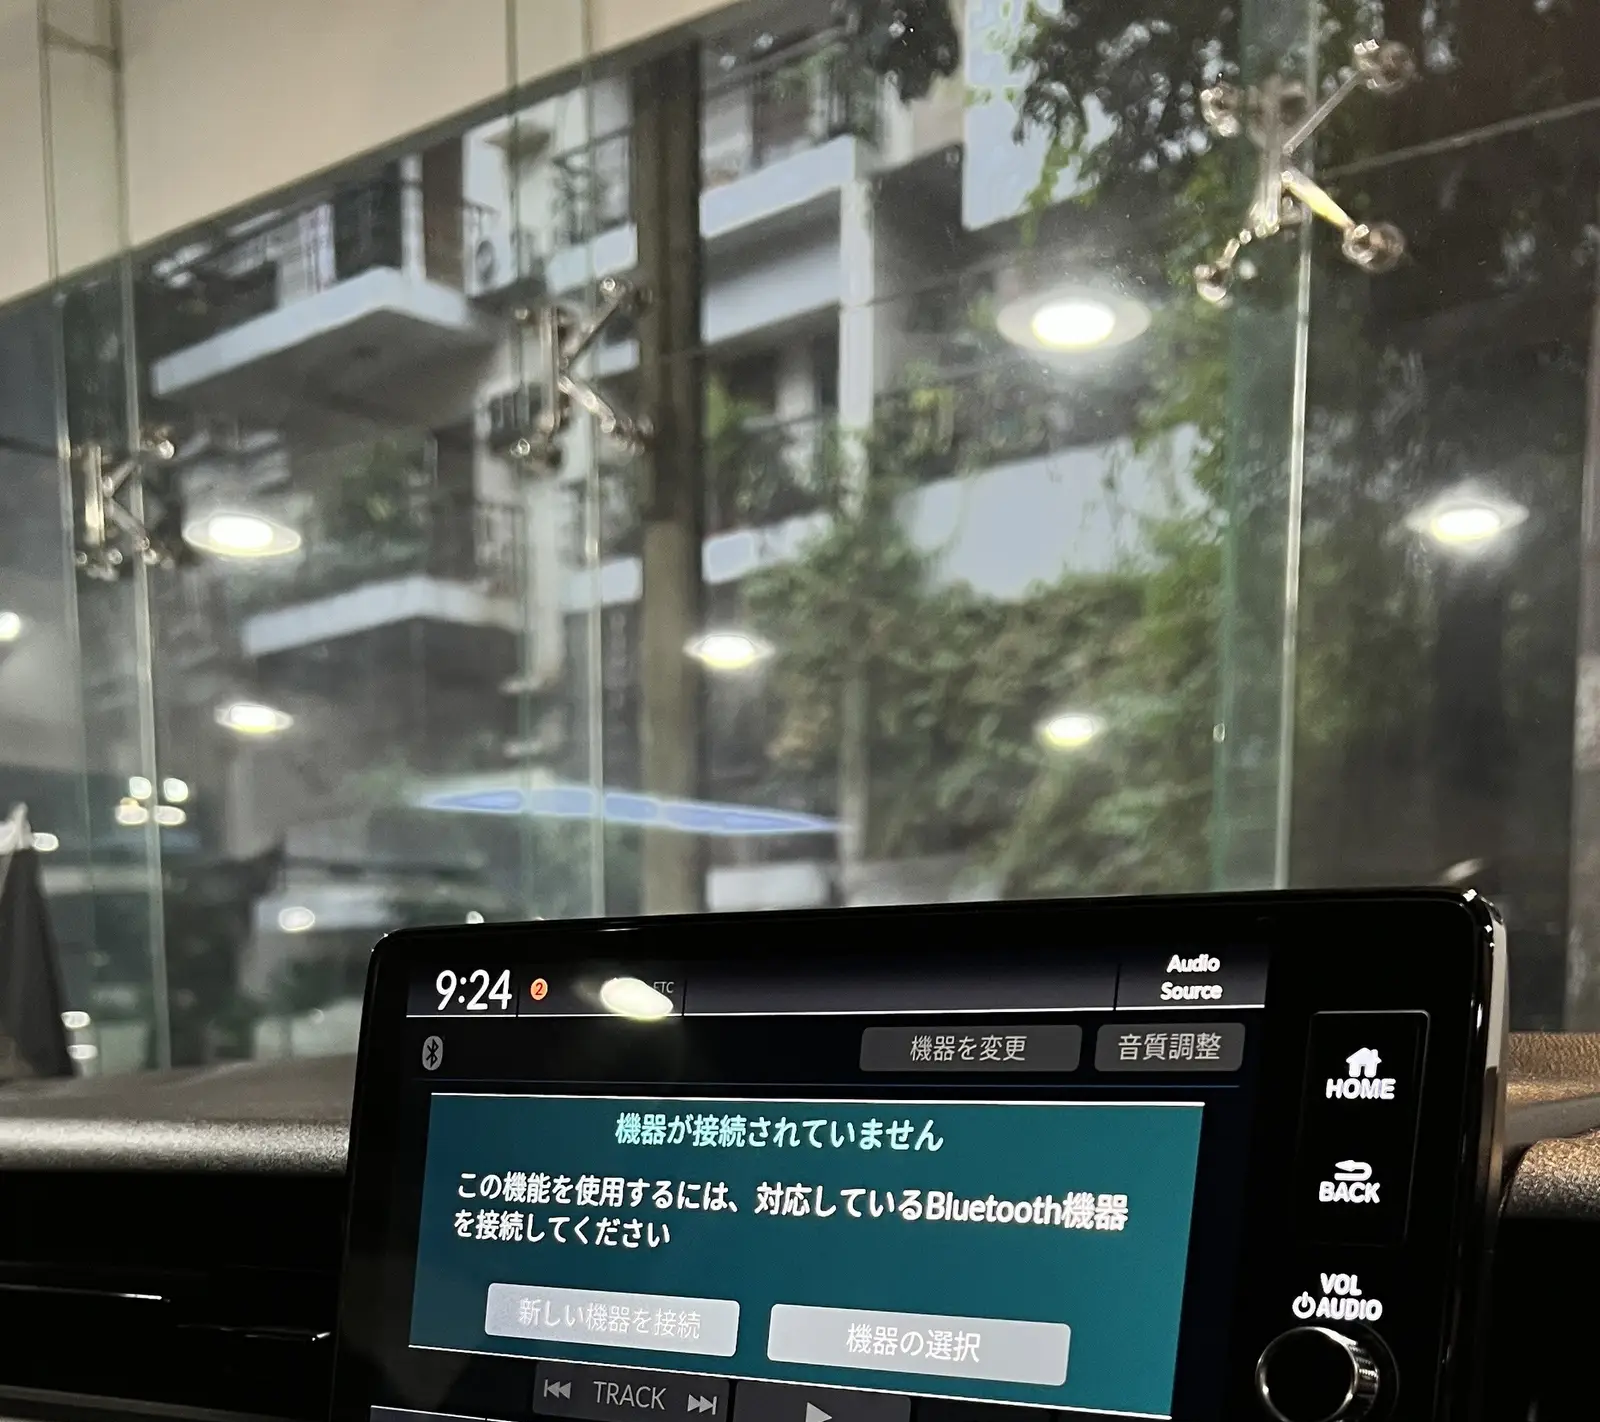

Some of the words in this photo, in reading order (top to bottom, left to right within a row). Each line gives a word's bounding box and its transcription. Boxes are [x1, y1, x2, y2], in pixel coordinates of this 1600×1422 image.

[1167, 953, 1221, 974] Audio
[435, 968, 512, 1011] 9:24
[1160, 979, 1223, 1001] Source
[910, 1034, 1027, 1063] 機器を変更
[1118, 1032, 1222, 1062] 音質調整
[1325, 1078, 1396, 1101] HOME
[615, 1111, 945, 1153] 機器が接続されていません
[1318, 1181, 1381, 1205] BACK
[451, 1209, 672, 1249] を接続してください
[1320, 1273, 1362, 1295] VOL
[517, 1298, 702, 1341] 新しい機器を接続
[1315, 1297, 1383, 1321] AUDIO
[845, 1322, 982, 1363] 機器の選択
[593, 1381, 667, 1411] TRACK
